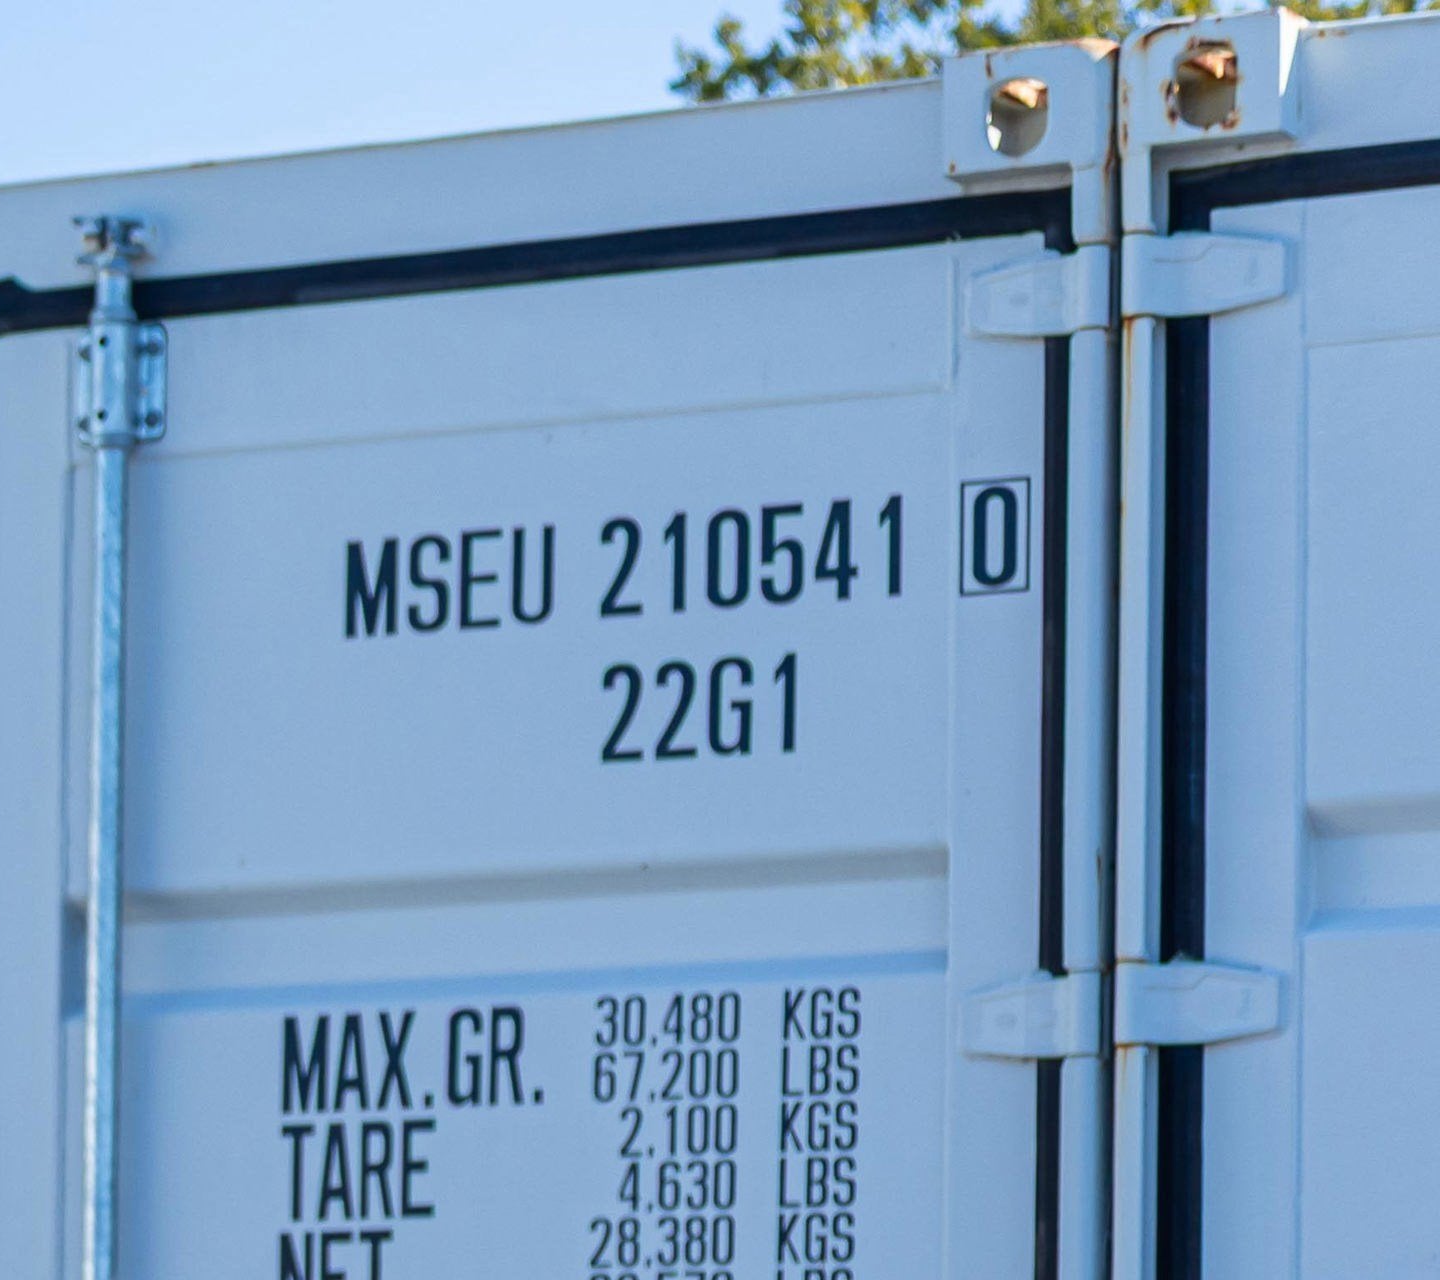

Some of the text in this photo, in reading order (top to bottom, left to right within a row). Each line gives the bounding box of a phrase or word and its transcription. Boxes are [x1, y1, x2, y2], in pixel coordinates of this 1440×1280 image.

[345, 487, 1017, 638] MSEU 210541 0
[601, 653, 796, 763] 22G1
[282, 988, 860, 1113] MAX.GR. 30,480 KGS
[592, 1045, 859, 1103] 67,200 LBS
[281, 1100, 857, 1221] TARE 2,100 KGS
[619, 1156, 856, 1211] 4,630 LBS
[590, 1216, 735, 1268] 28,380
[777, 1212, 854, 1263] KGS
